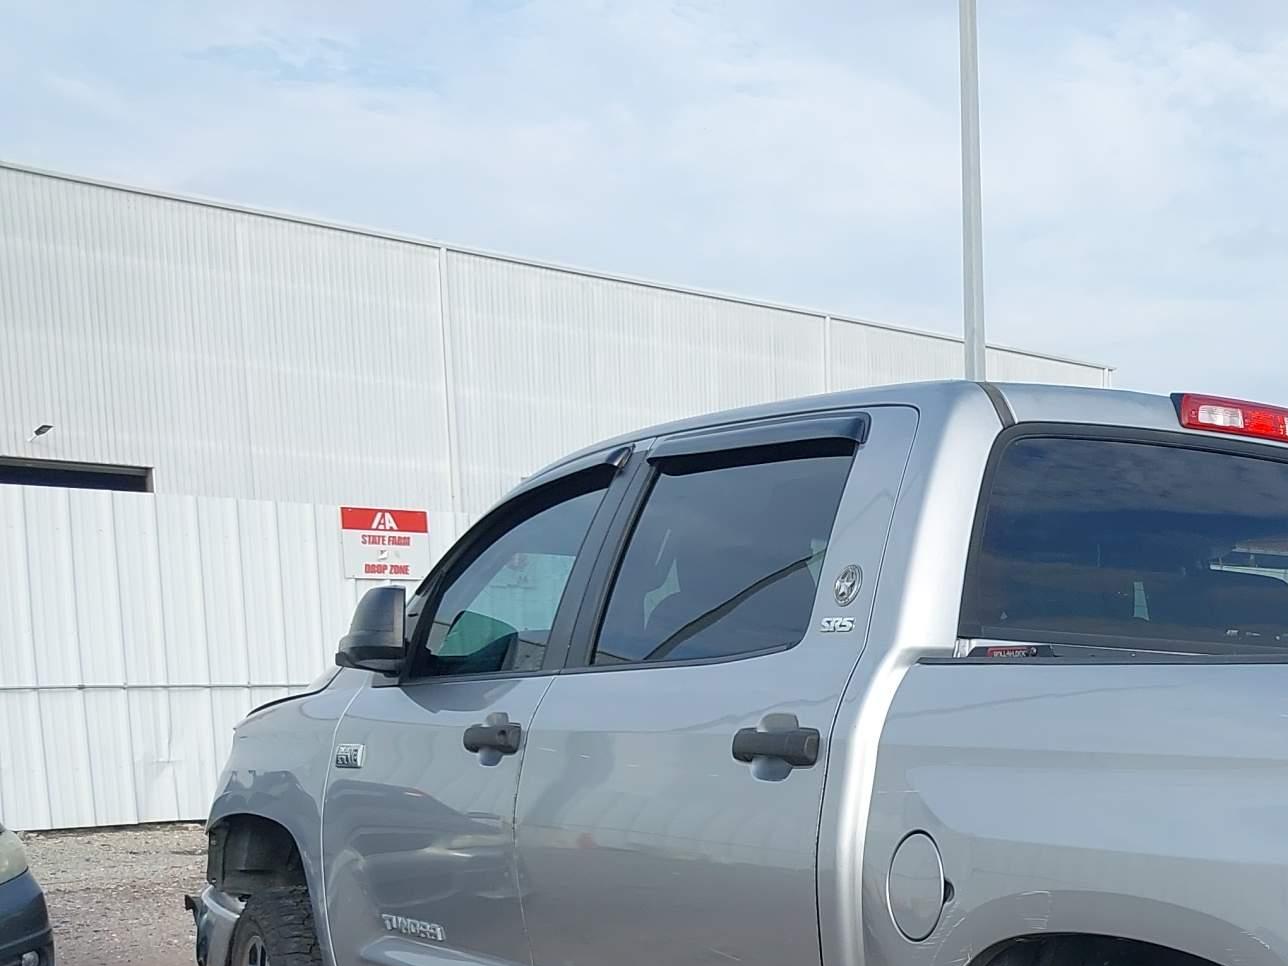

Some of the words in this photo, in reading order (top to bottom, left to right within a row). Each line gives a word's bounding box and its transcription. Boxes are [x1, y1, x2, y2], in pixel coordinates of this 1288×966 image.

[361, 534, 386, 546] STATE
[387, 535, 411, 546] FARM
[364, 563, 388, 575] DROP
[389, 564, 411, 576] ZONE
[820, 617, 856, 633] SR5
[381, 913, 447, 941] TUNDRA
